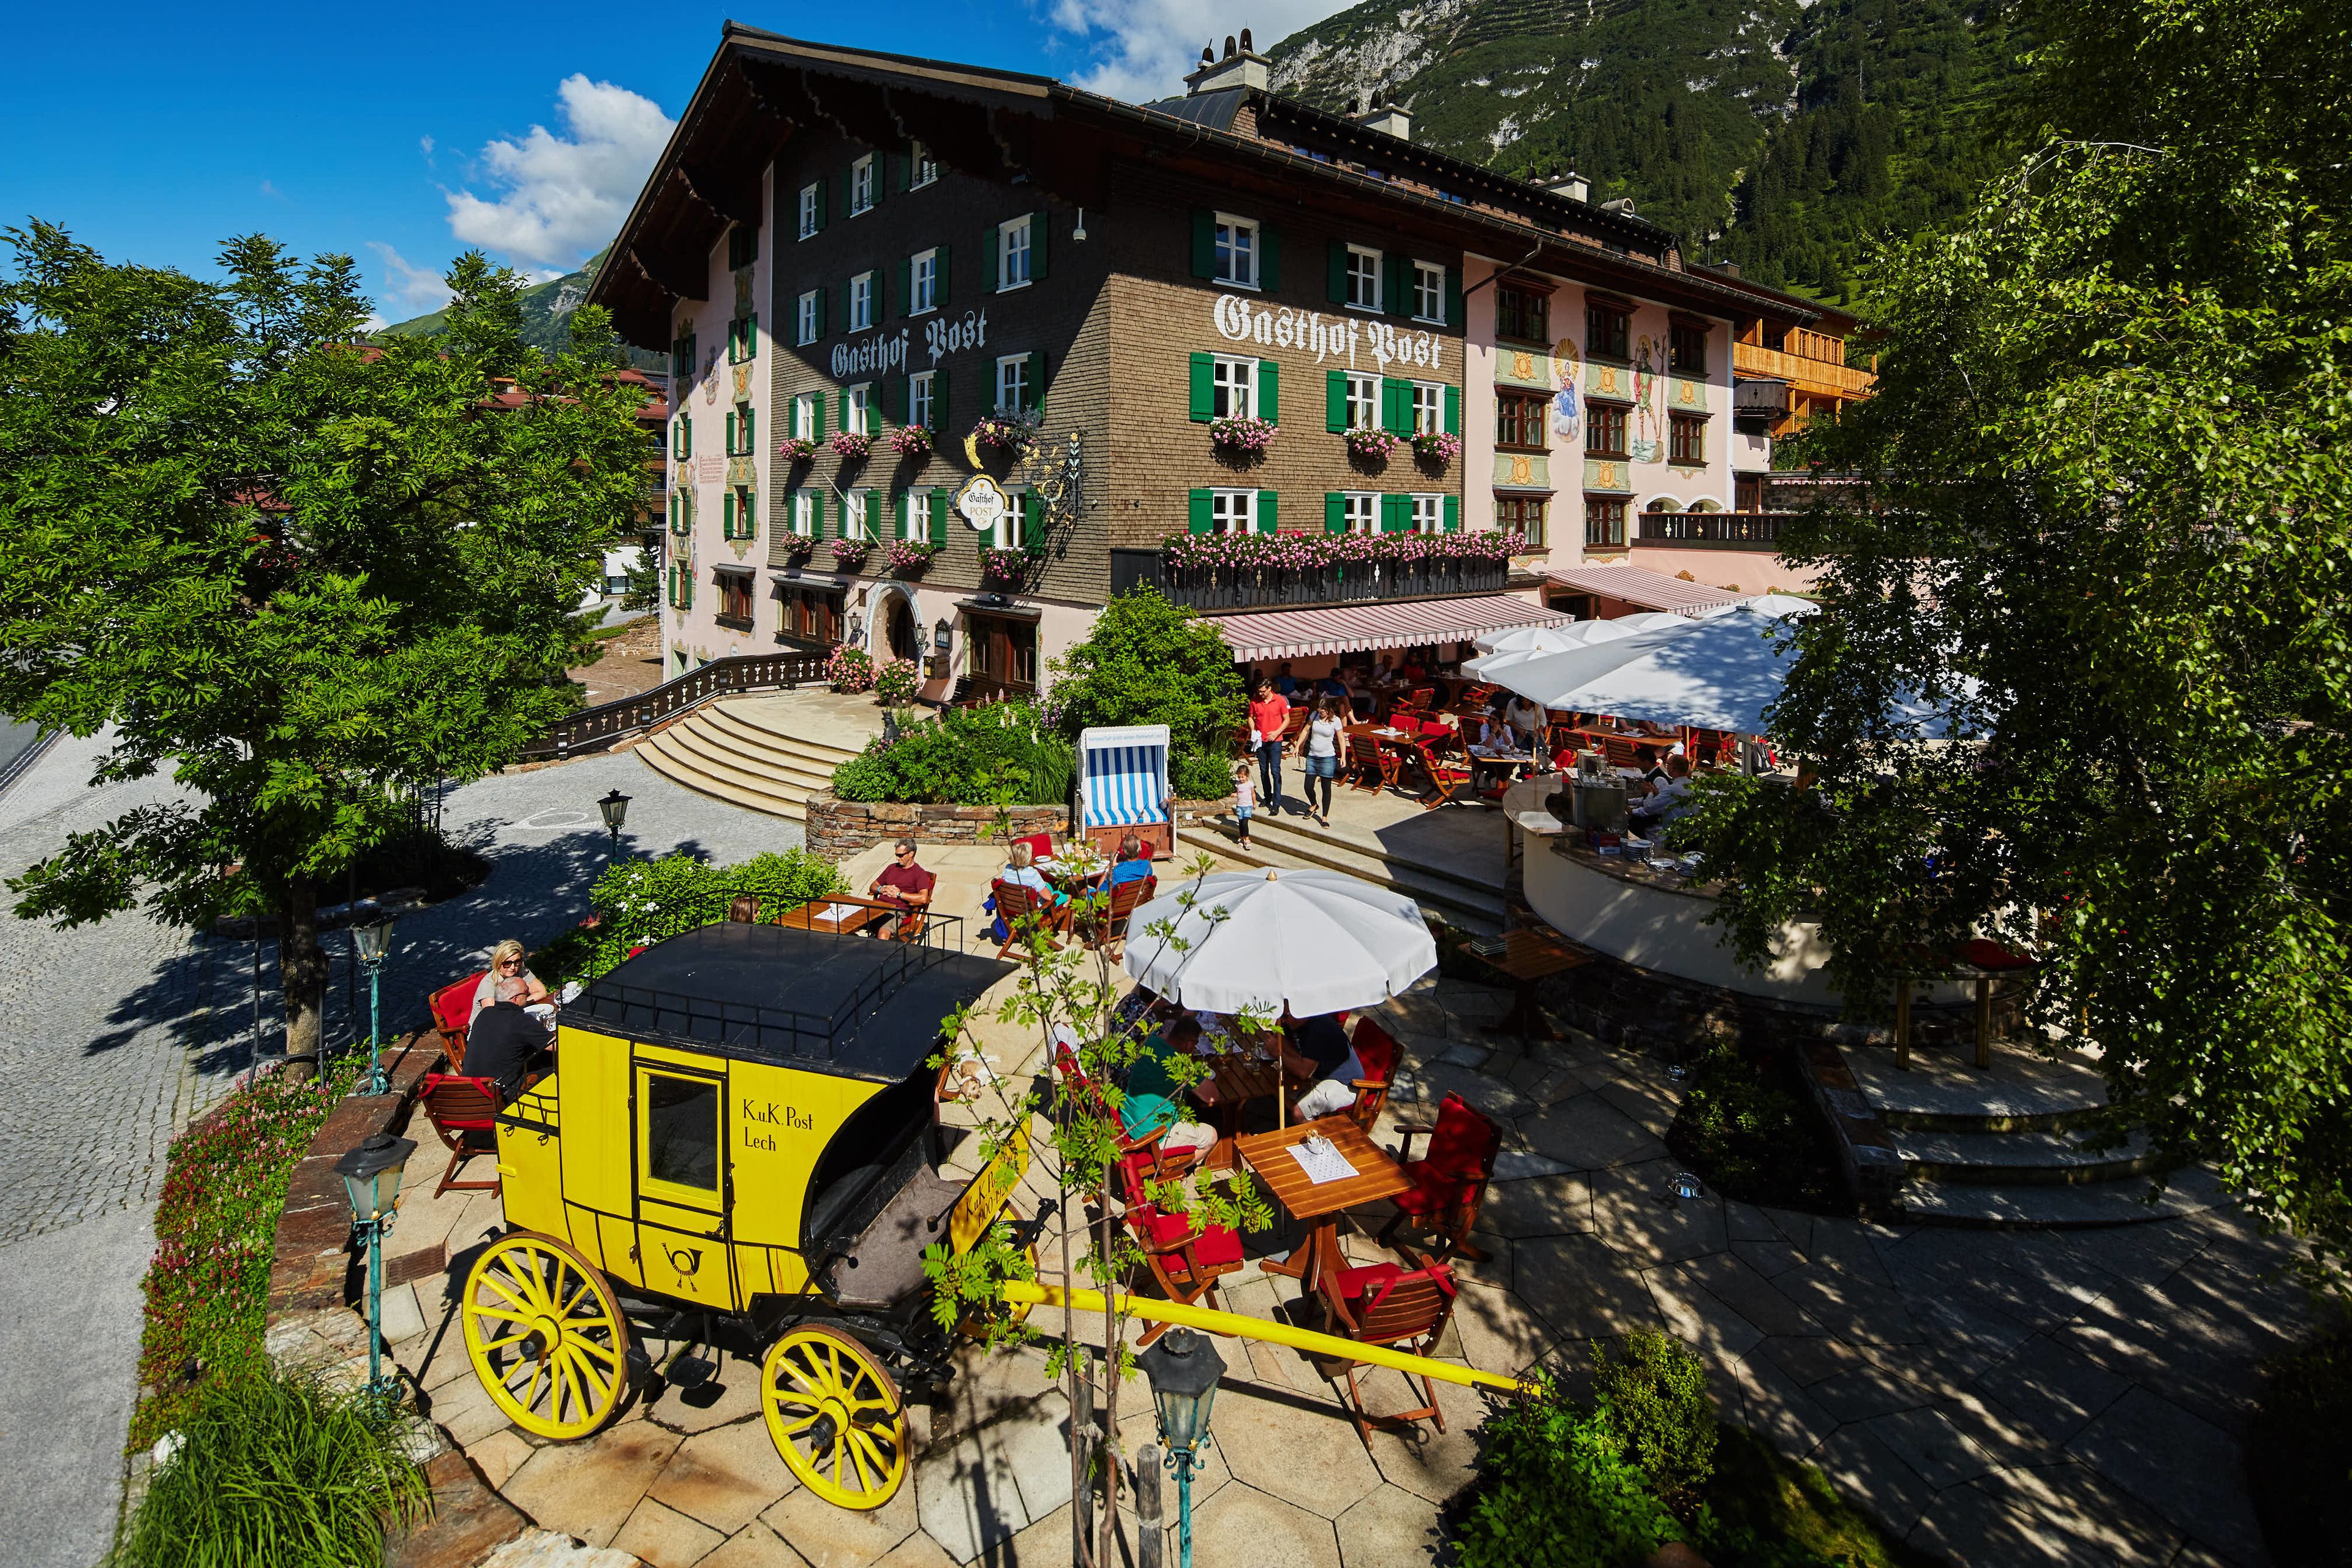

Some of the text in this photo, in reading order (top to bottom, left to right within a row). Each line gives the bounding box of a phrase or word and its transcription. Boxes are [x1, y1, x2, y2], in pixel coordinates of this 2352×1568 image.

[831, 306, 987, 378] Gasthof Post
[1213, 293, 1442, 374] Gasthof Post
[970, 507, 993, 516] POST
[786, 1106, 814, 1131] Post
[745, 1126, 776, 1152] Lech
